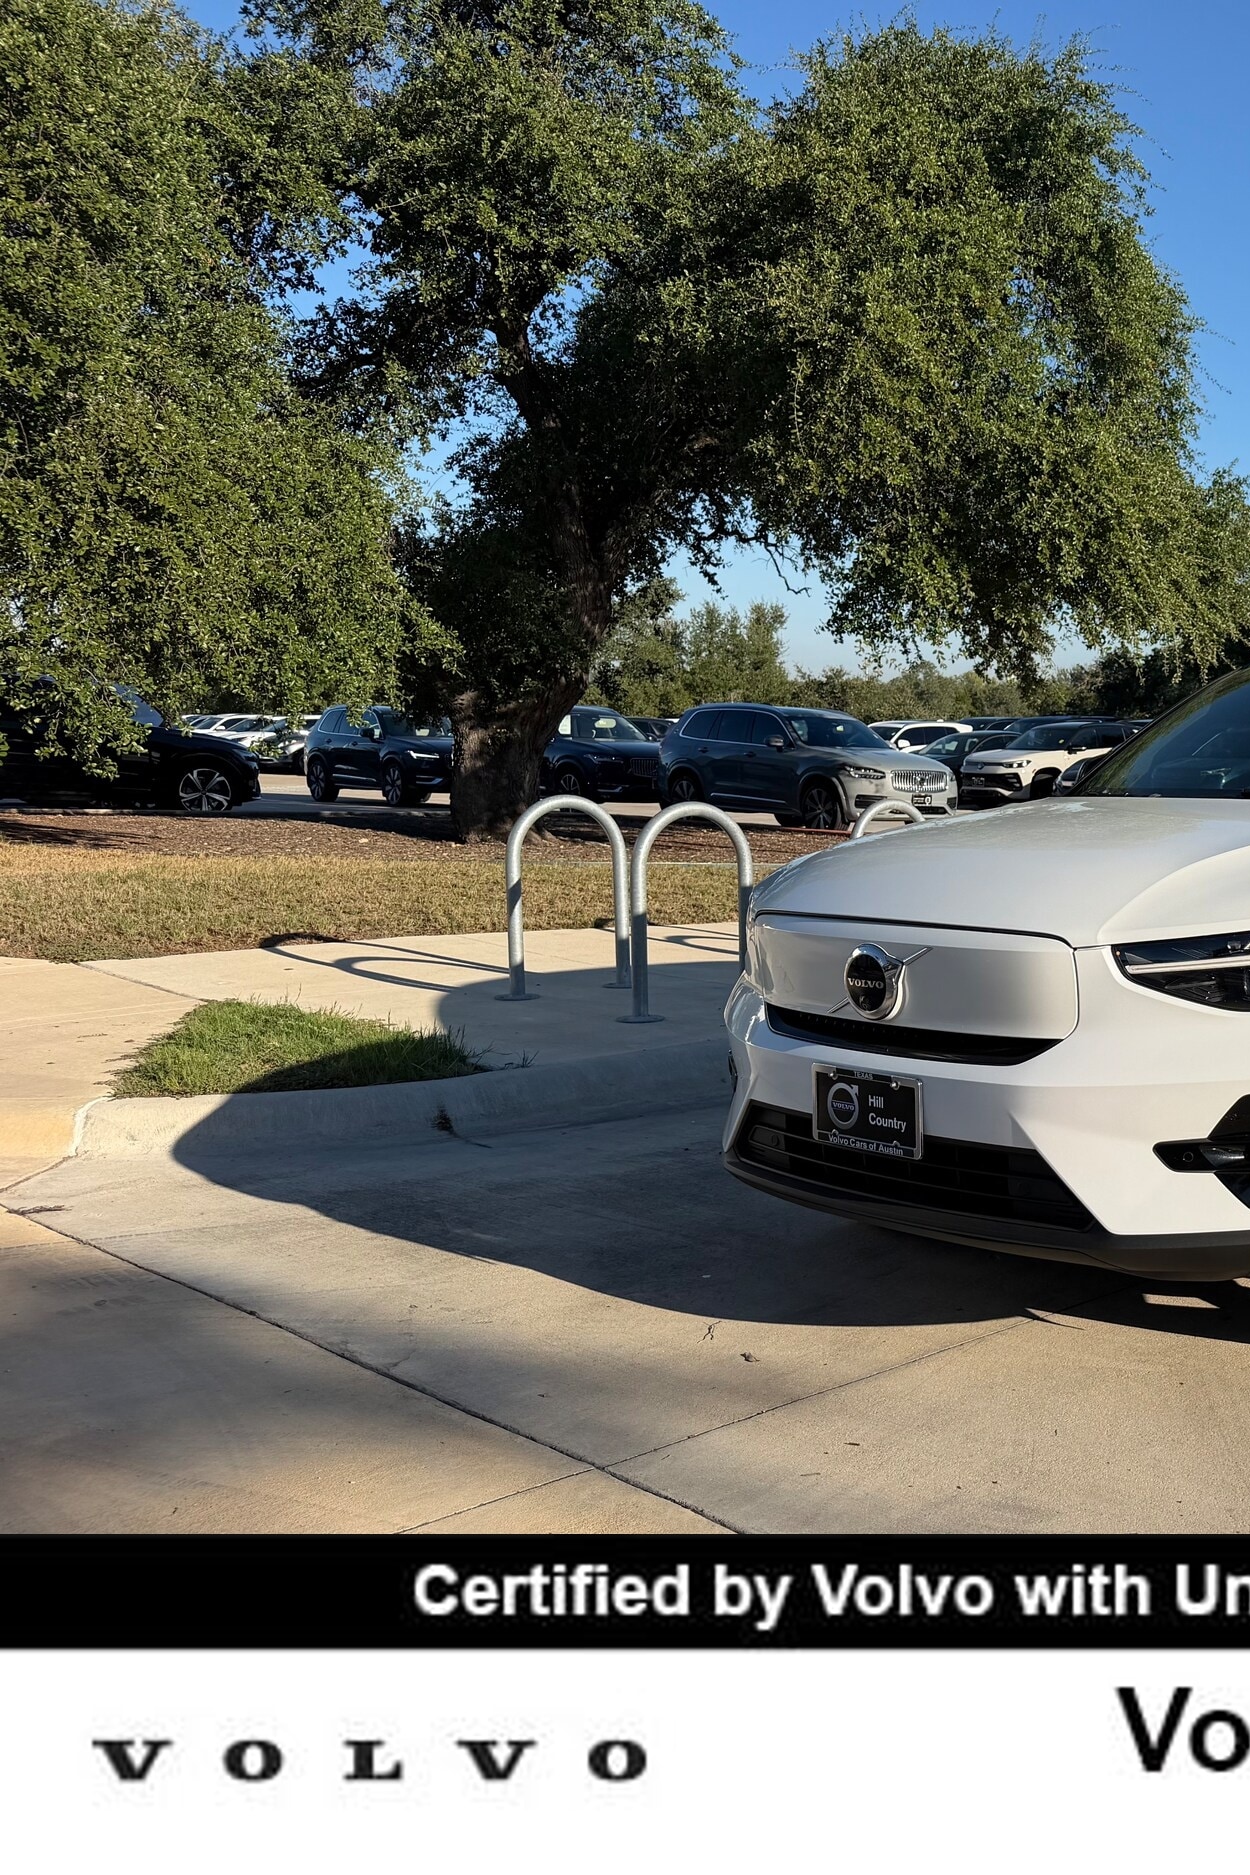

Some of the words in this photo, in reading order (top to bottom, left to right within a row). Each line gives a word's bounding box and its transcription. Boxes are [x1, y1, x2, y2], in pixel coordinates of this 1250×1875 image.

[847, 977, 884, 989] VOLVO
[853, 1071, 874, 1081] TEXAS
[832, 1101, 855, 1111] VOLVO
[868, 1095, 884, 1109] Hill
[868, 1112, 907, 1133] Country
[828, 1133, 849, 1145] Volvo
[849, 1138, 868, 1150] Cars
[868, 1141, 877, 1151] of
[878, 1143, 904, 1156] Austin
